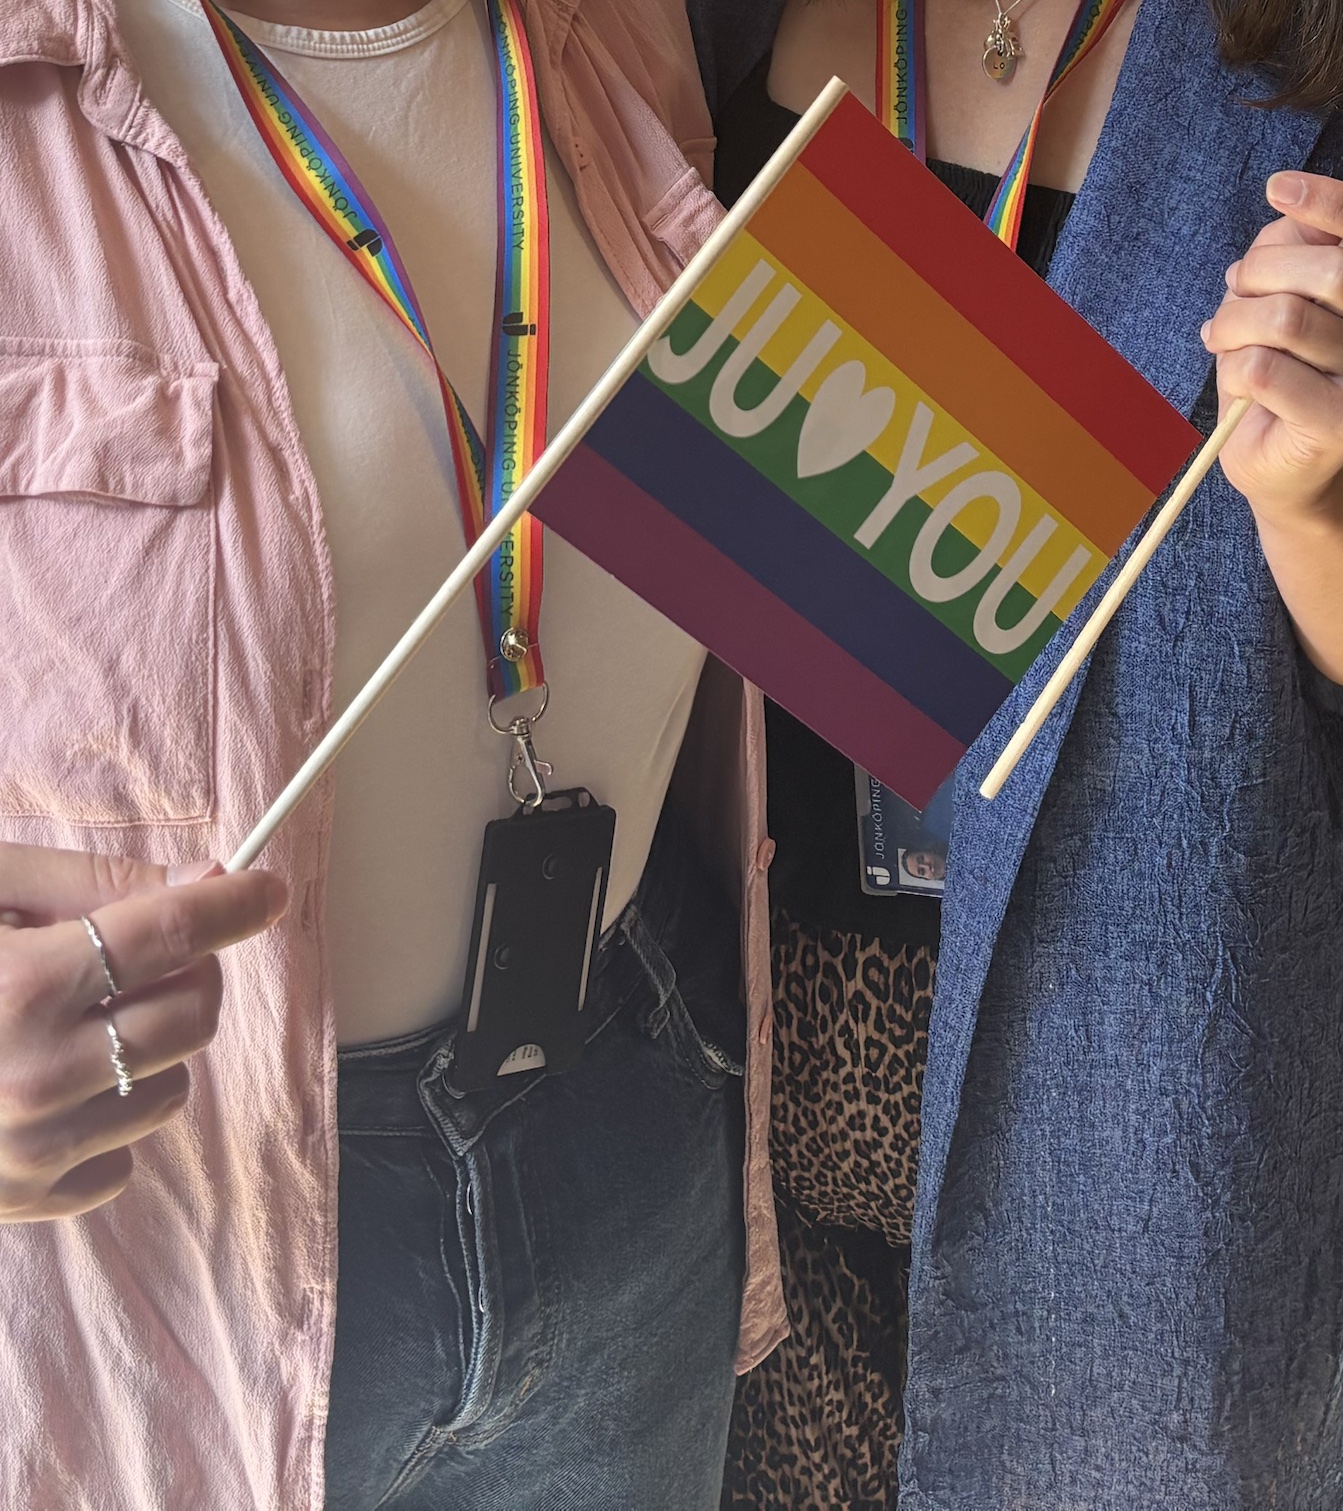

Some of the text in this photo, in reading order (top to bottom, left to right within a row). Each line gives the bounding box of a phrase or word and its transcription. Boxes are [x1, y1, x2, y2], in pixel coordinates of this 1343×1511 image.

[893, 8, 908, 125] JÖNKÖPING
[278, 111, 358, 220] JÖNKÖPING
[508, 132, 525, 251] UNIVERSITY
[498, 349, 524, 617] JÖNKÖPING UERSITY
[647, 258, 1093, 655] JU YOU
